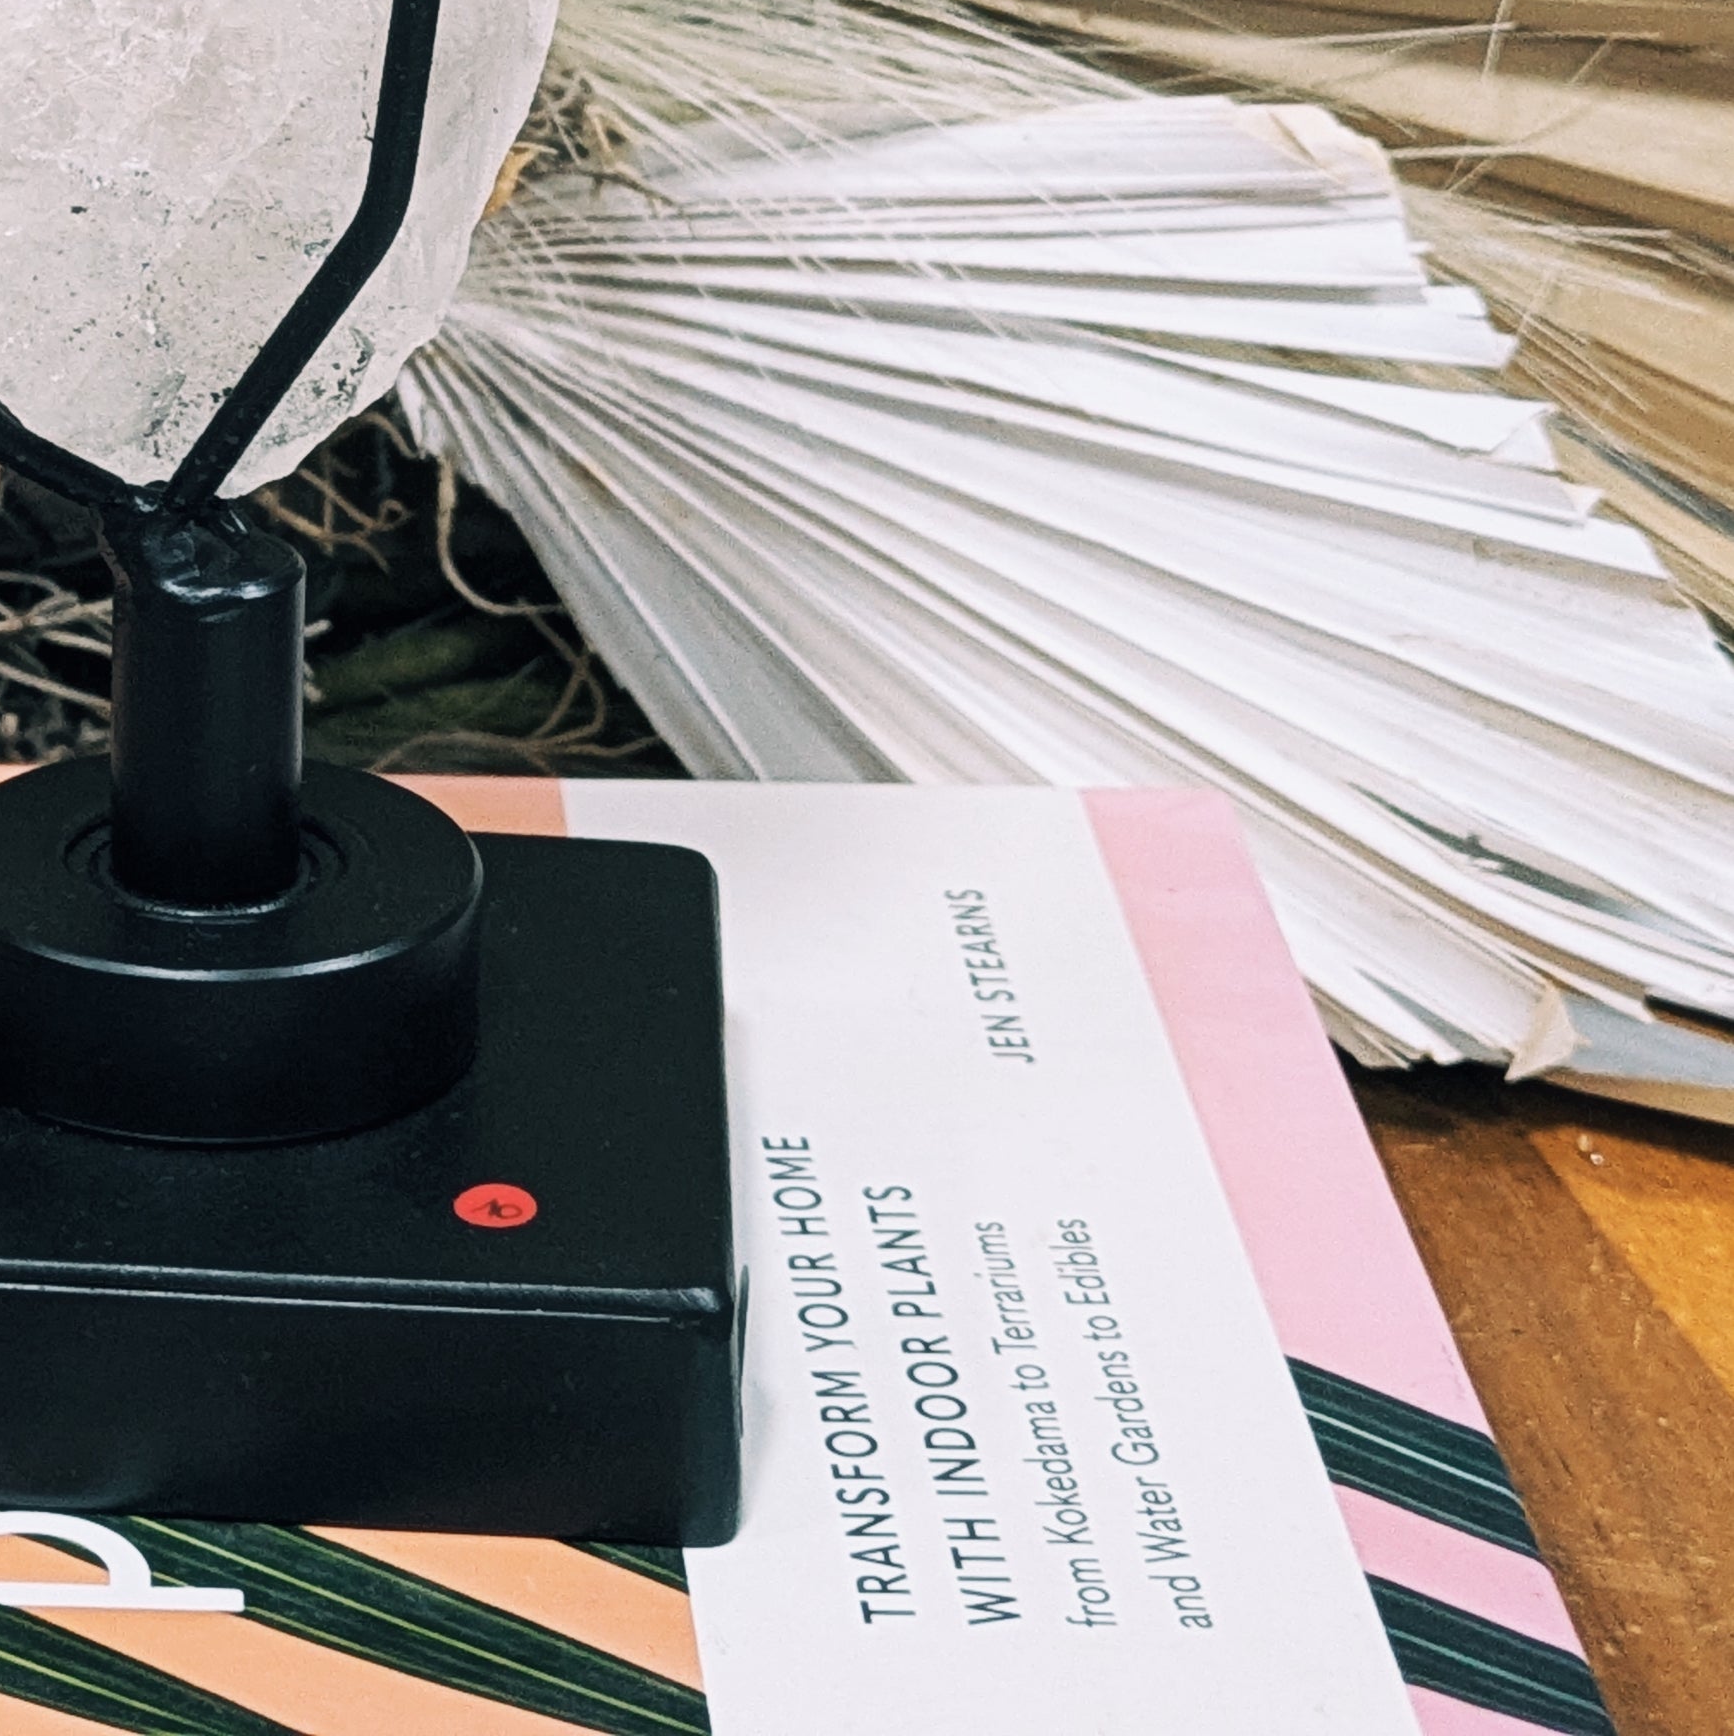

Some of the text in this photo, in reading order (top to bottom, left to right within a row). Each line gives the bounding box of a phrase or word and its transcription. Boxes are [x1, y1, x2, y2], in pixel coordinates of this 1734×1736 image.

[944, 889, 1036, 1064] JEN STEARNS
[761, 1136, 917, 1625] TRANSFORM YOUR HOME
[861, 1185, 1022, 1626] WITH INDOOR PLANTS
[973, 1221, 1118, 1628] from Kokedama to Terrariums
[1049, 1219, 1214, 1629] and Water Gardens to Edibles
